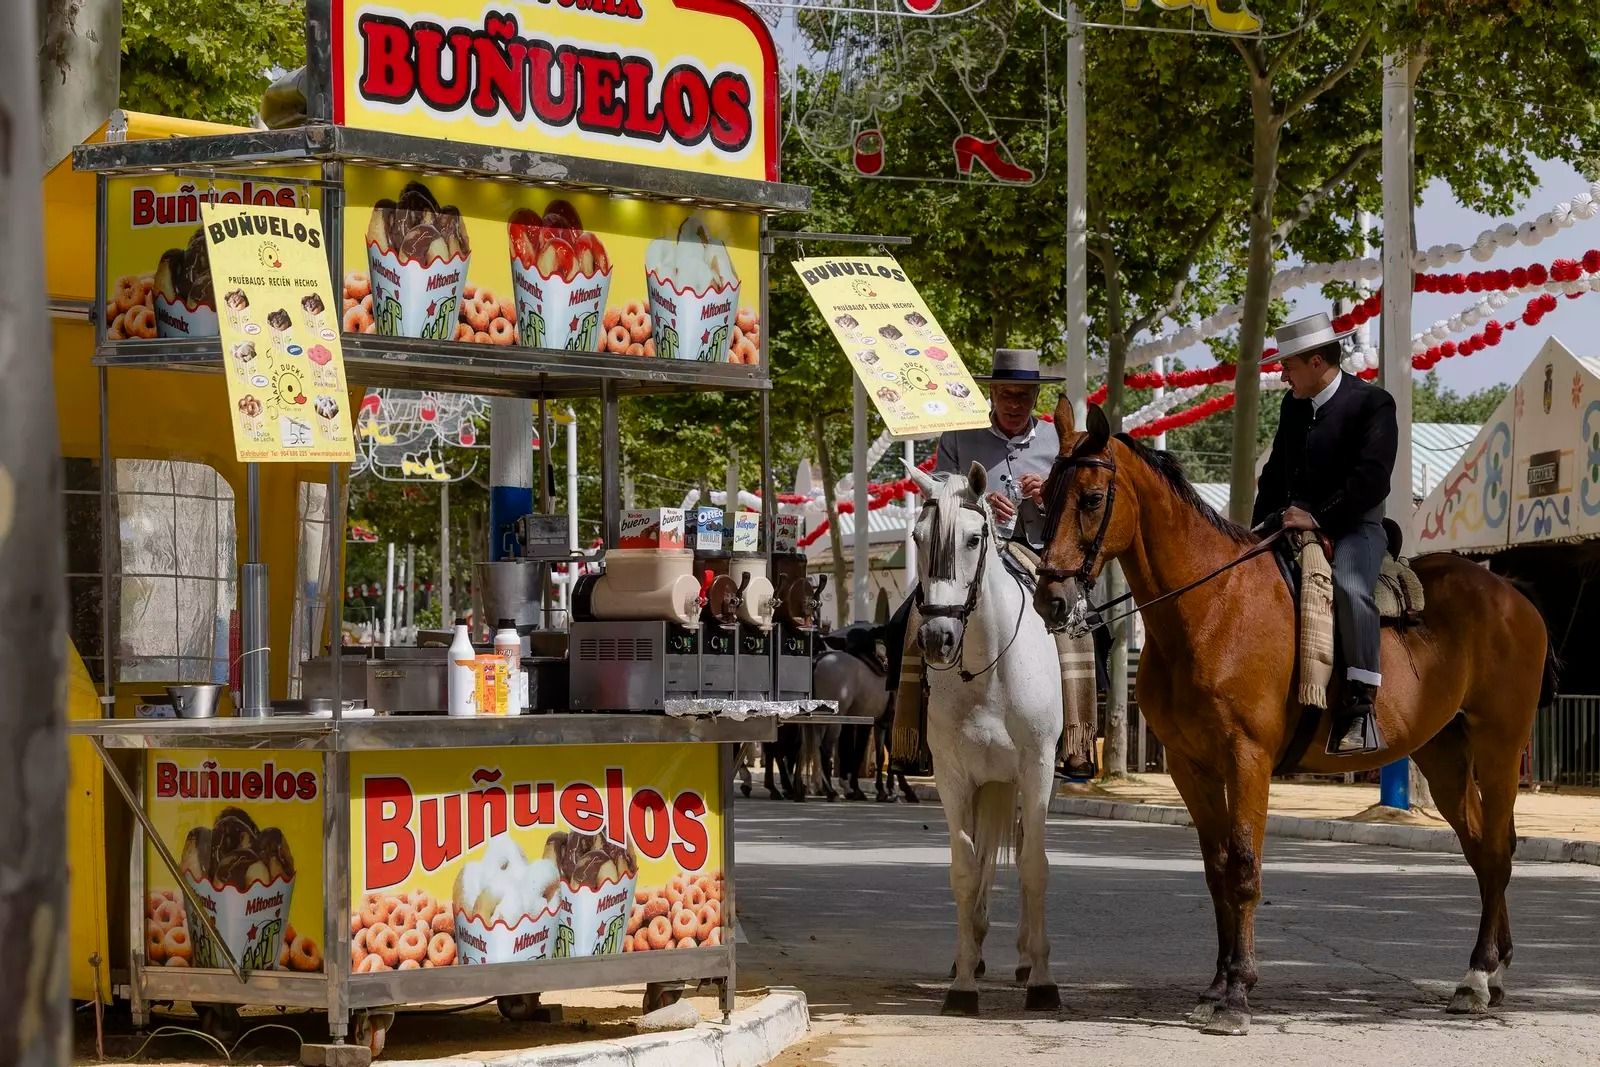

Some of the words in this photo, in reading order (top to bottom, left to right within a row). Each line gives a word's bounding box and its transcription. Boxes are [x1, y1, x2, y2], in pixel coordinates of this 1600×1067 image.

[359, 11, 752, 152] BUÑUELOS
[208, 212, 320, 249] BUÑUELOS
[228, 275, 265, 286] PRUÉBALOS
[269, 275, 291, 287] RECIÉN
[294, 278, 318, 287] HECHOS
[372, 256, 401, 289] Mitomix
[426, 269, 460, 292] Mitomix
[802, 261, 906, 285] BUÑUELOS
[568, 283, 602, 307] Mitomix
[700, 298, 732, 321] Mitomix
[280, 363, 304, 380] DUCKY
[621, 516, 650, 532] bueno
[662, 514, 683, 526] bueno
[698, 509, 724, 523] OREO
[156, 761, 318, 800] Buñuelos
[364, 768, 708, 891] Buñuelos
[245, 890, 284, 917] Mitomix
[596, 887, 629, 915] Mitomix
[512, 924, 550, 955] Mitomix
